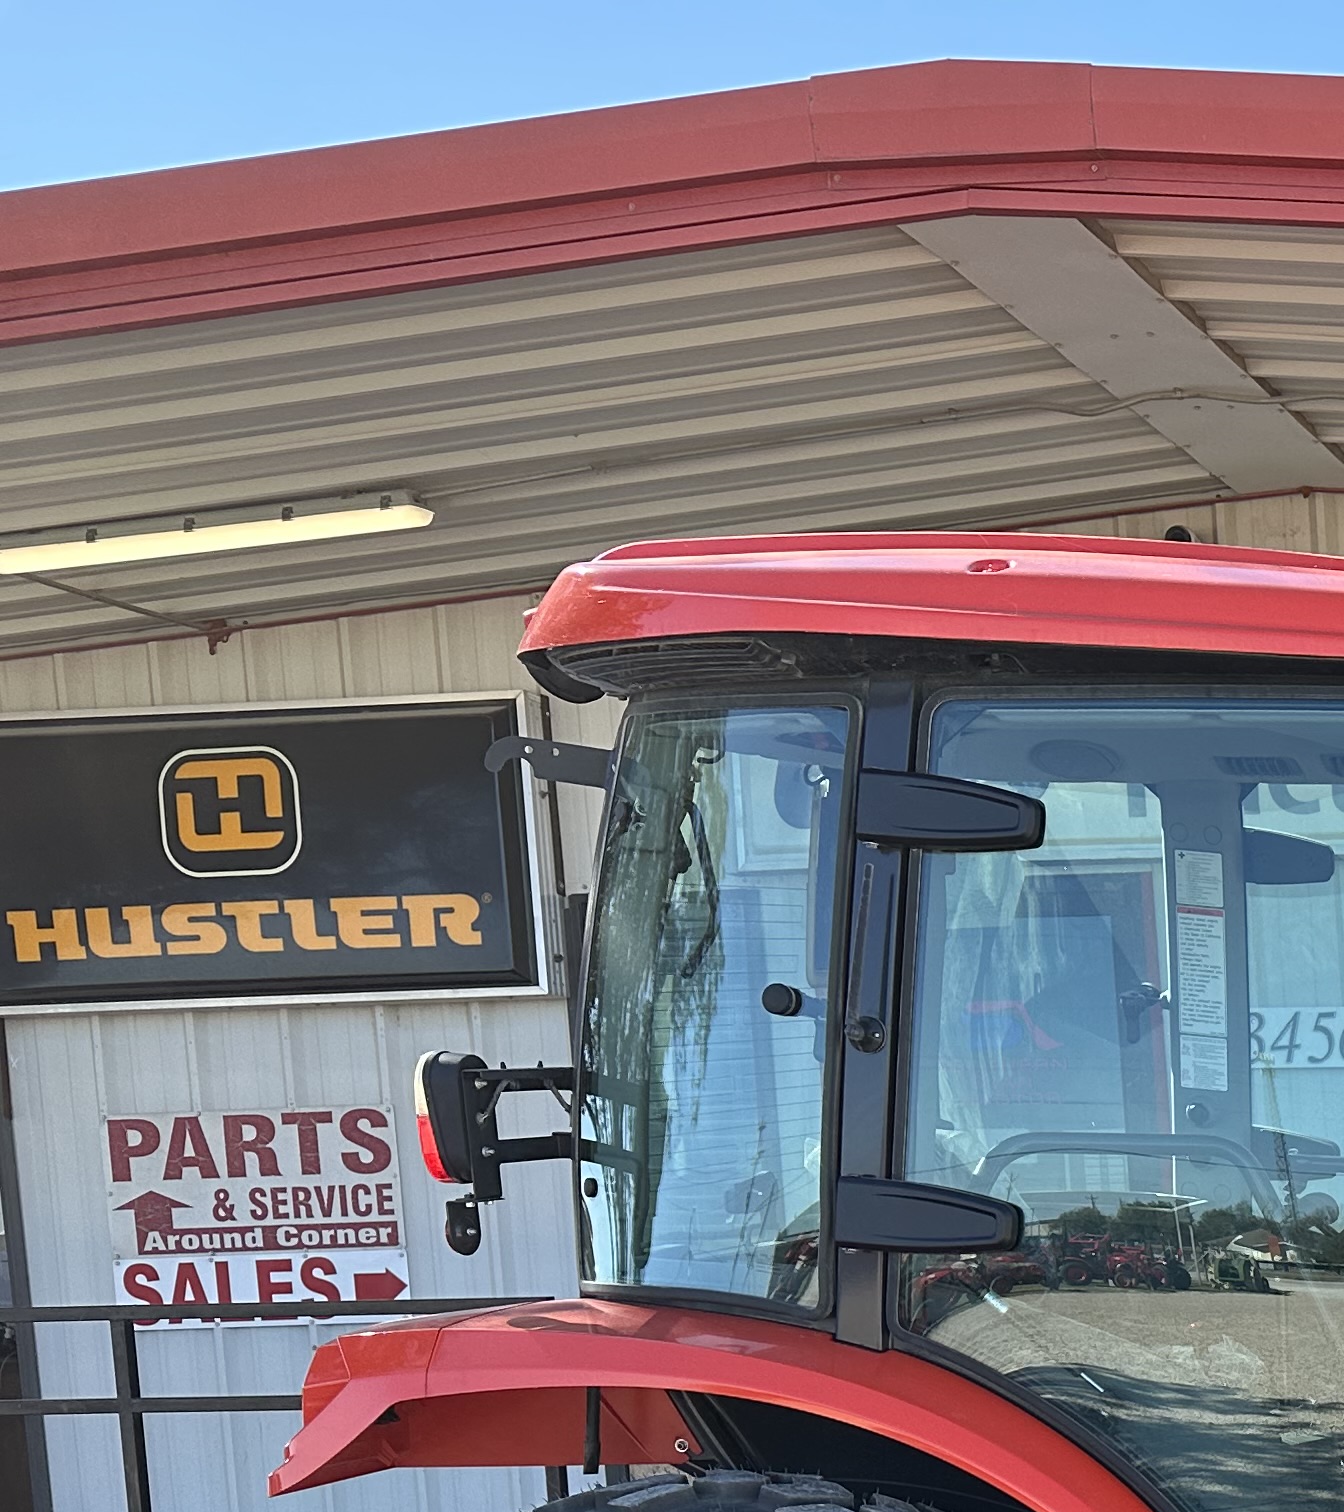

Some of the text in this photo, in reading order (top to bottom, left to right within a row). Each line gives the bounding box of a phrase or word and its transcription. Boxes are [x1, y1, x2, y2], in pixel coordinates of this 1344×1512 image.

[6, 893, 483, 963] HUSTLER
[107, 1108, 392, 1182] PARTS
[212, 1183, 395, 1221] & SERVICE
[143, 1225, 392, 1251] Around Corner
[123, 1257, 341, 1326] SALES
